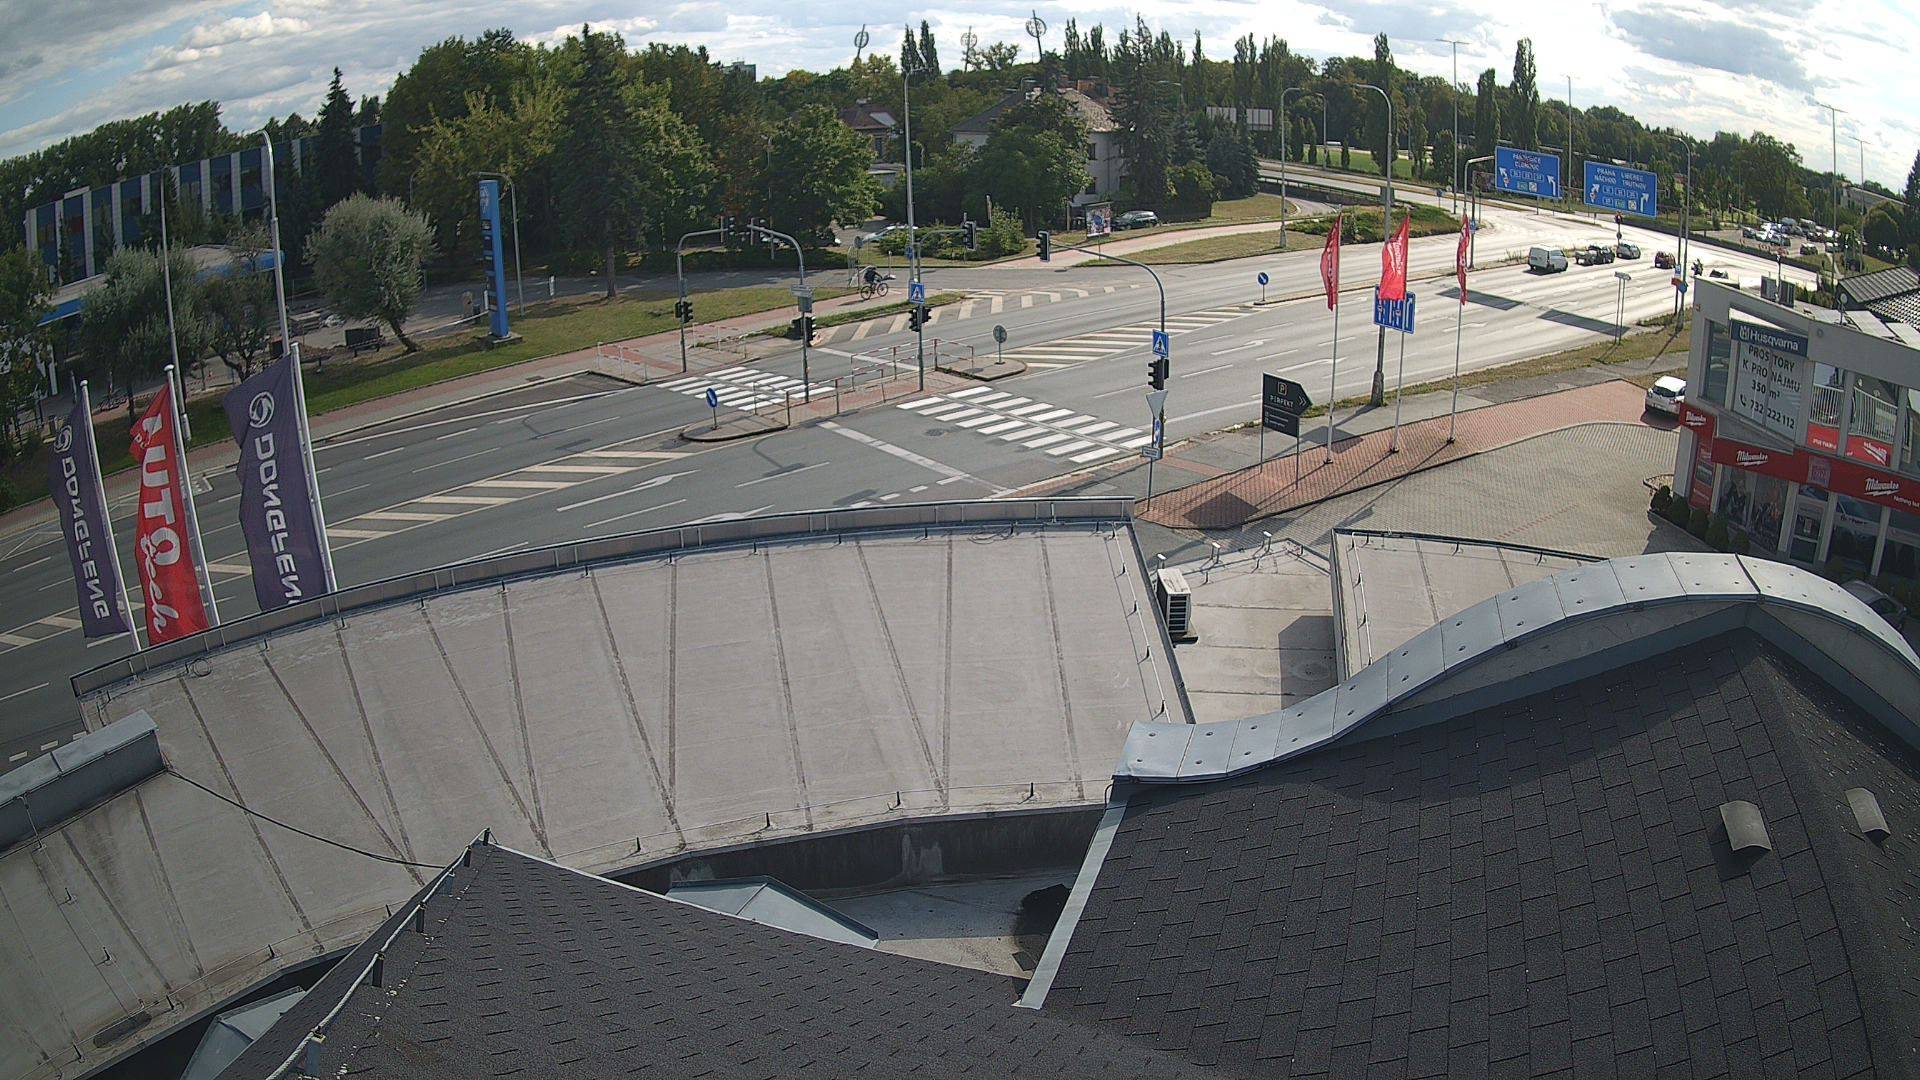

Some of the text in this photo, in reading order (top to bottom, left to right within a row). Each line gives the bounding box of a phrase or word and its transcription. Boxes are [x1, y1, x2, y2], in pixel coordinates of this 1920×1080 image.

[1750, 328, 1798, 350] Husqvarna
[1742, 359, 1749, 370] K
[1751, 379, 1766, 394] 350
[1750, 399, 1764, 414] 732
